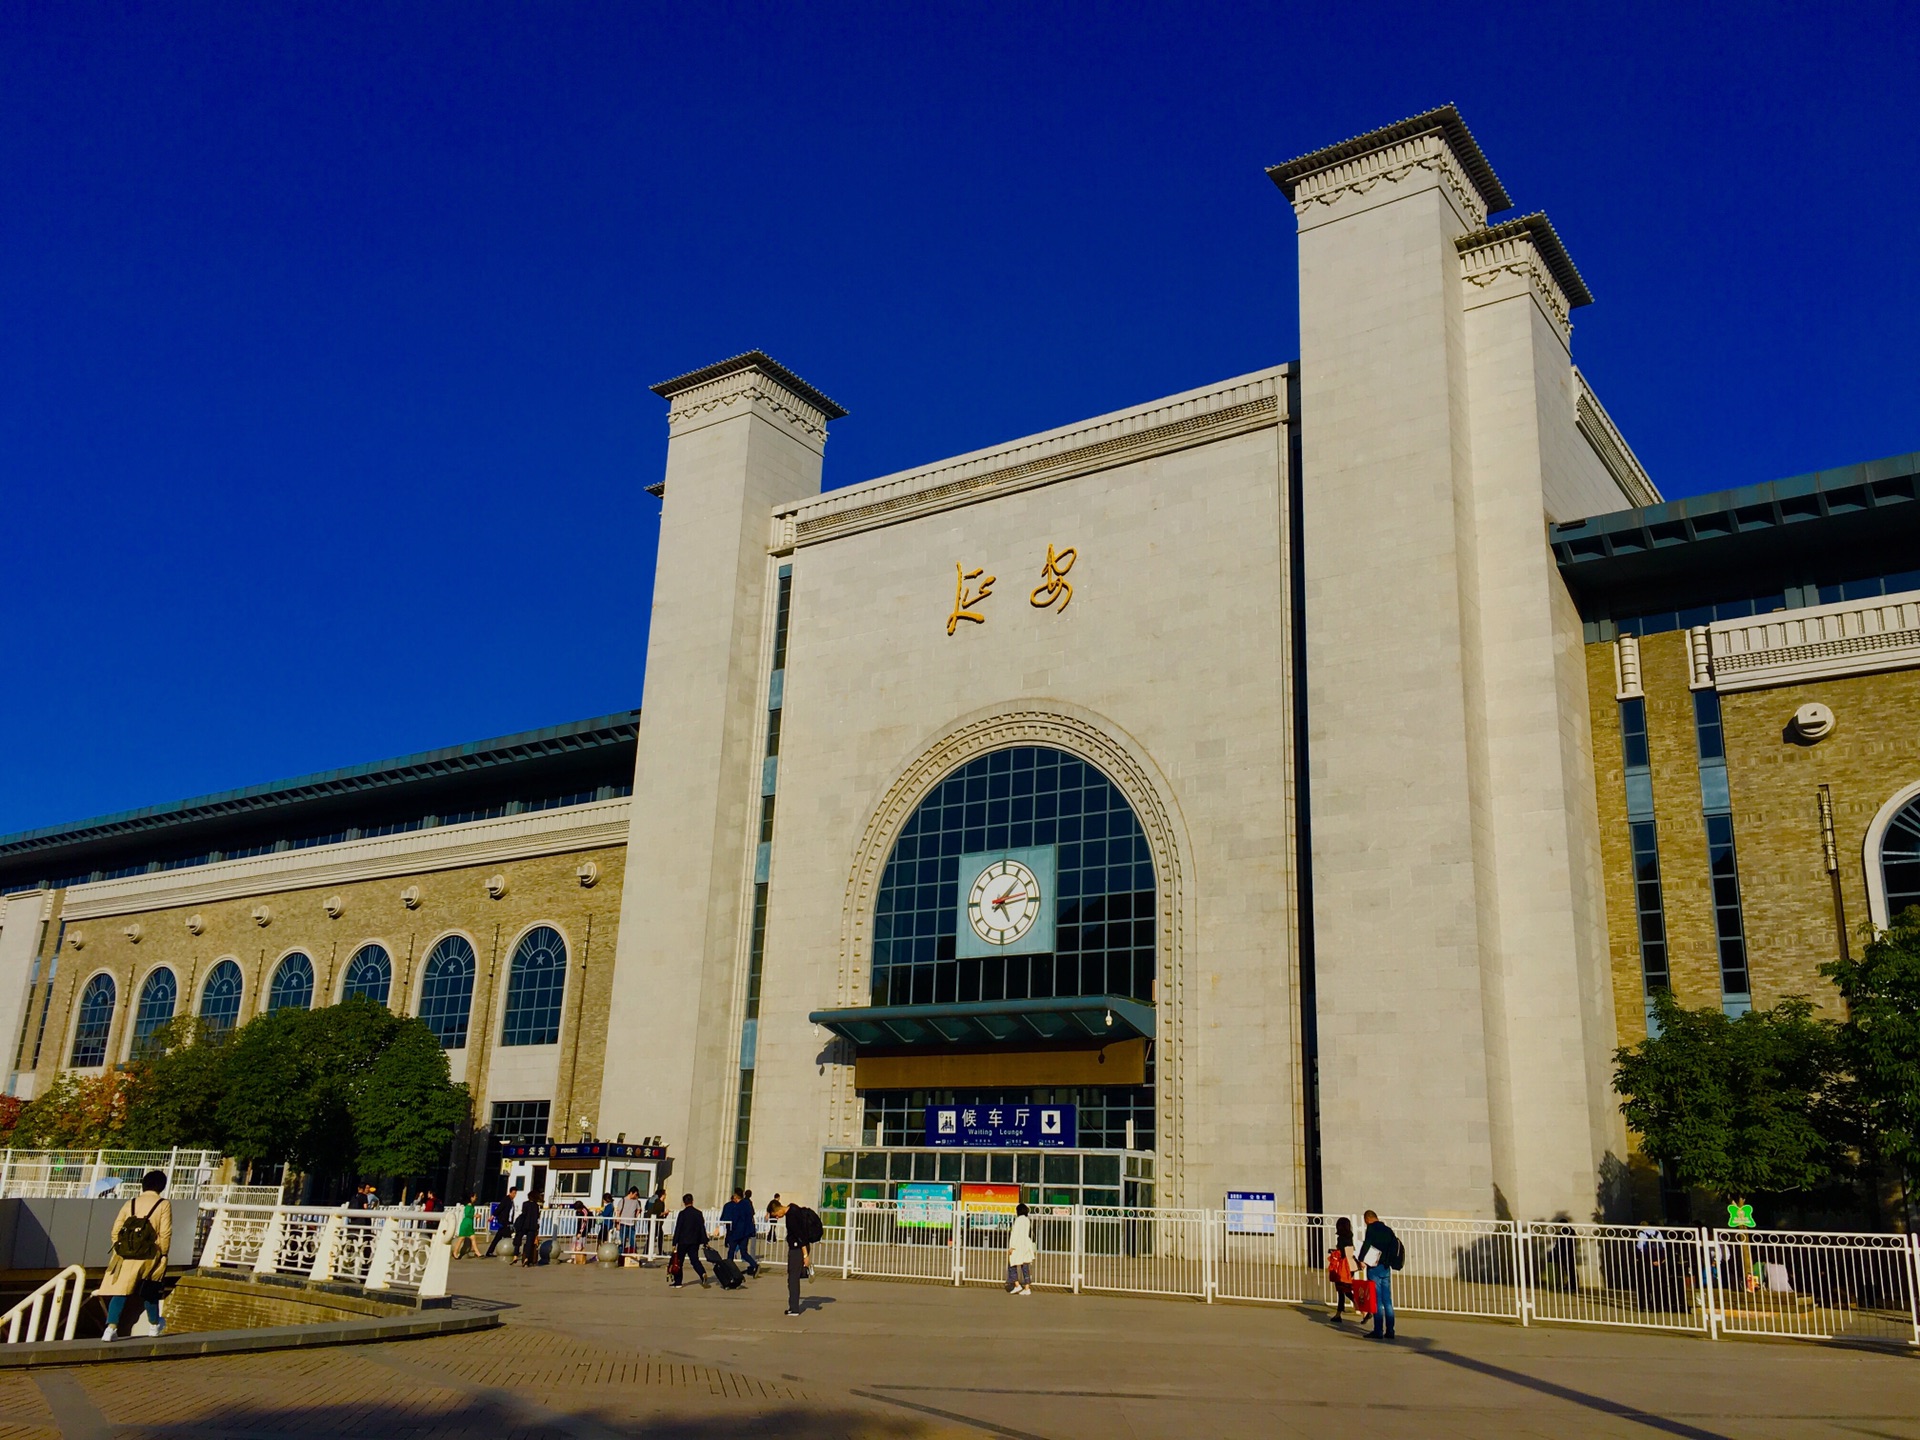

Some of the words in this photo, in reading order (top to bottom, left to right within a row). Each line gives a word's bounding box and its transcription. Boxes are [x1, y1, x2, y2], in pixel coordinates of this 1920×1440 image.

[962, 1108, 1030, 1128] 候车厅
[528, 1146, 545, 1156] 公安
